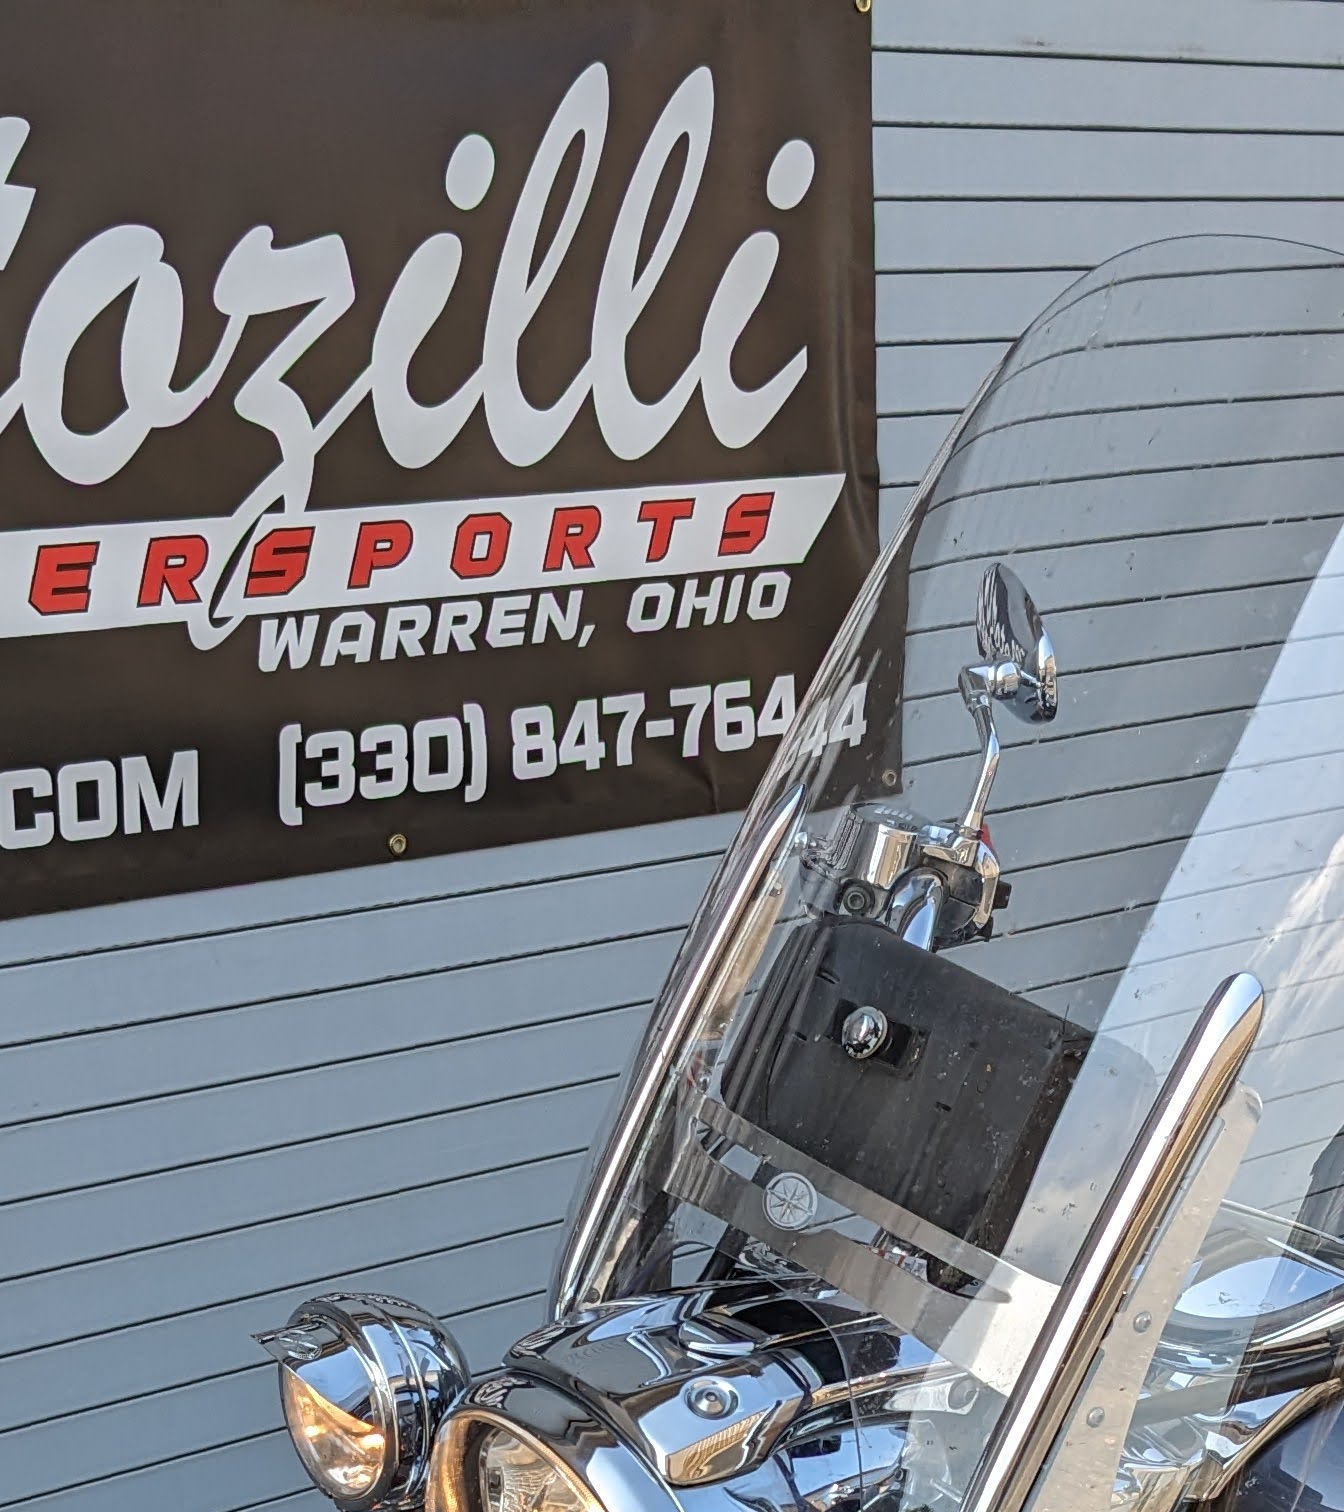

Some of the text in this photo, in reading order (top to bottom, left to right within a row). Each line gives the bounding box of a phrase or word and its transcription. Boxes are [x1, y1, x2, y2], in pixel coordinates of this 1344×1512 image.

[256, 570, 793, 673] WARREN, OHIO
[278, 702, 489, 827] (330)
